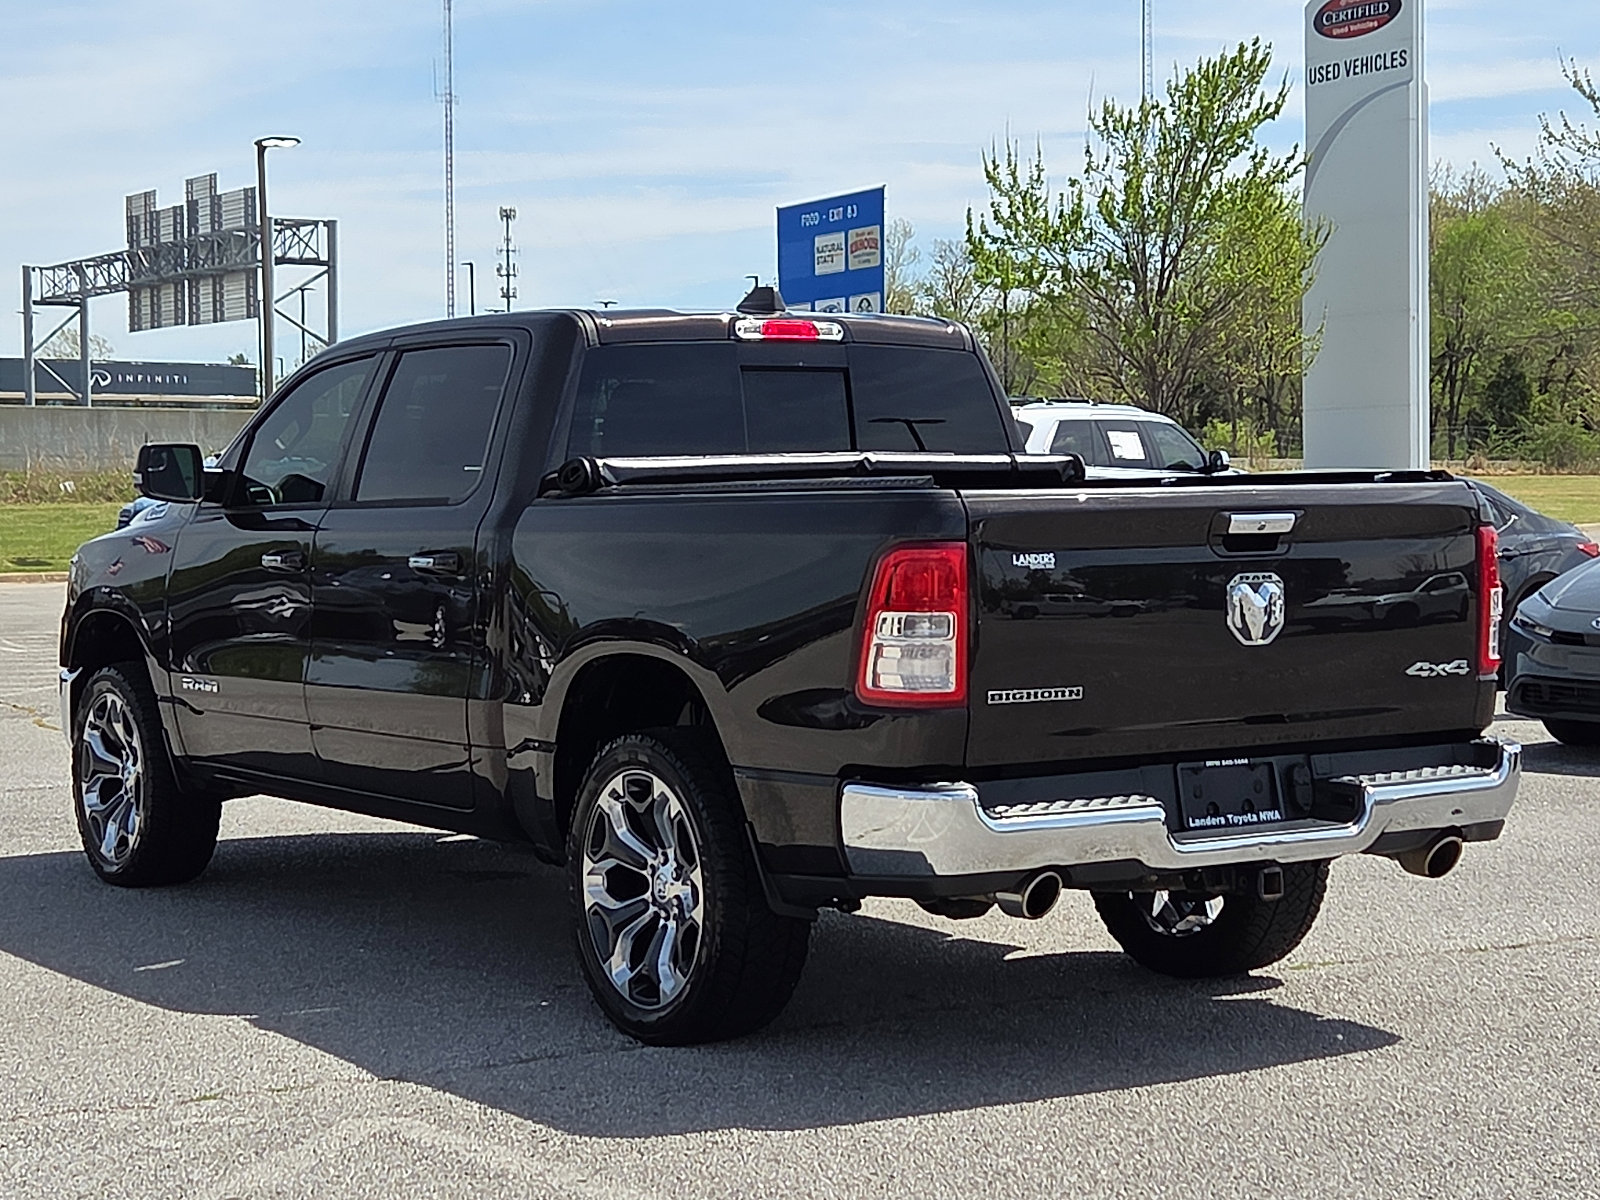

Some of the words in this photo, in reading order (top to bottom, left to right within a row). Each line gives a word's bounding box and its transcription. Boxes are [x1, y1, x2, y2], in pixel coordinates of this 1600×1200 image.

[1322, 2, 1390, 26] CERTIFIED
[1309, 62, 1341, 85] USED
[1344, 49, 1408, 78] VEHICLES
[801, 211, 820, 227] FOOD
[828, 207, 844, 222] EXIT
[816, 242, 844, 254] NATURAL
[117, 374, 188, 384] INFINITI
[1012, 552, 1056, 567] LANDERS
[181, 677, 218, 693] RAM
[987, 686, 1083, 705] BIGHORN
[1188, 815, 1226, 828] Landers
[1226, 812, 1259, 826] Toyota
[1259, 809, 1281, 821] NWA
